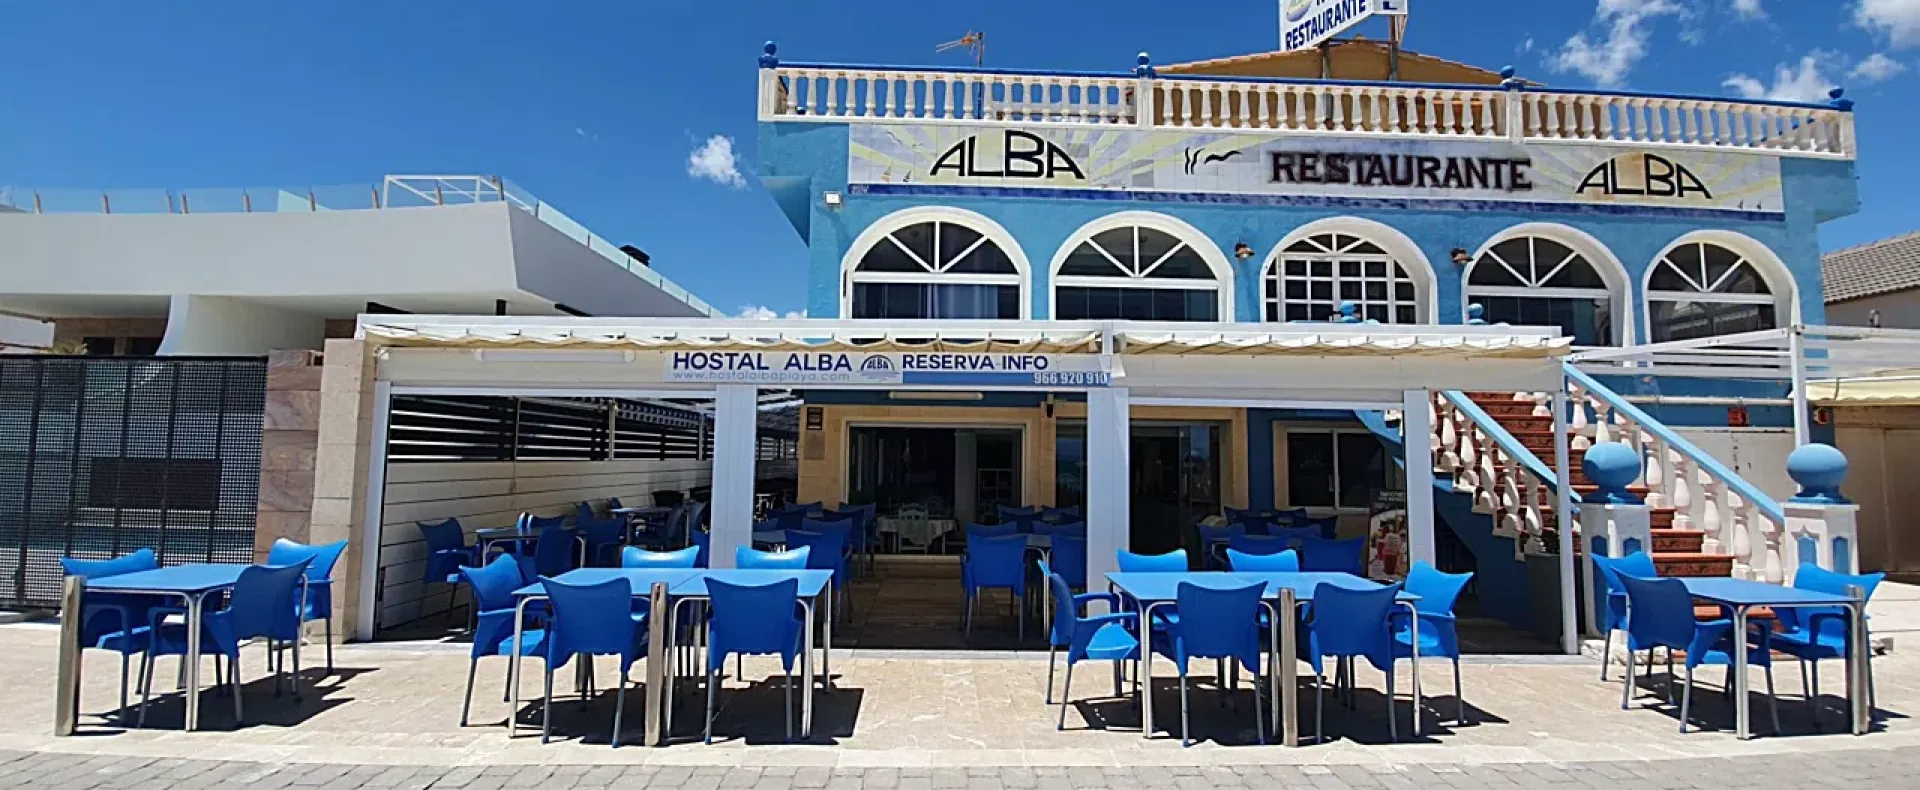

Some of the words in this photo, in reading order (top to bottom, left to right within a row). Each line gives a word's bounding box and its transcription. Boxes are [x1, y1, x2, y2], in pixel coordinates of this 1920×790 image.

[1285, 0, 1366, 50] RESTAURANTE
[929, 129, 1086, 180] ALBA
[1268, 150, 1533, 192] RESTAURANTE
[1575, 153, 1713, 199] ALBA
[673, 352, 770, 371] HOSTAL
[784, 353, 852, 372] ALBA
[1002, 354, 1049, 371] INFO
[672, 371, 851, 381] www.hostalalbaplaya.com
[1034, 372, 1057, 384] 966
[1061, 372, 1084, 384] 920
[1086, 372, 1108, 385] 910
